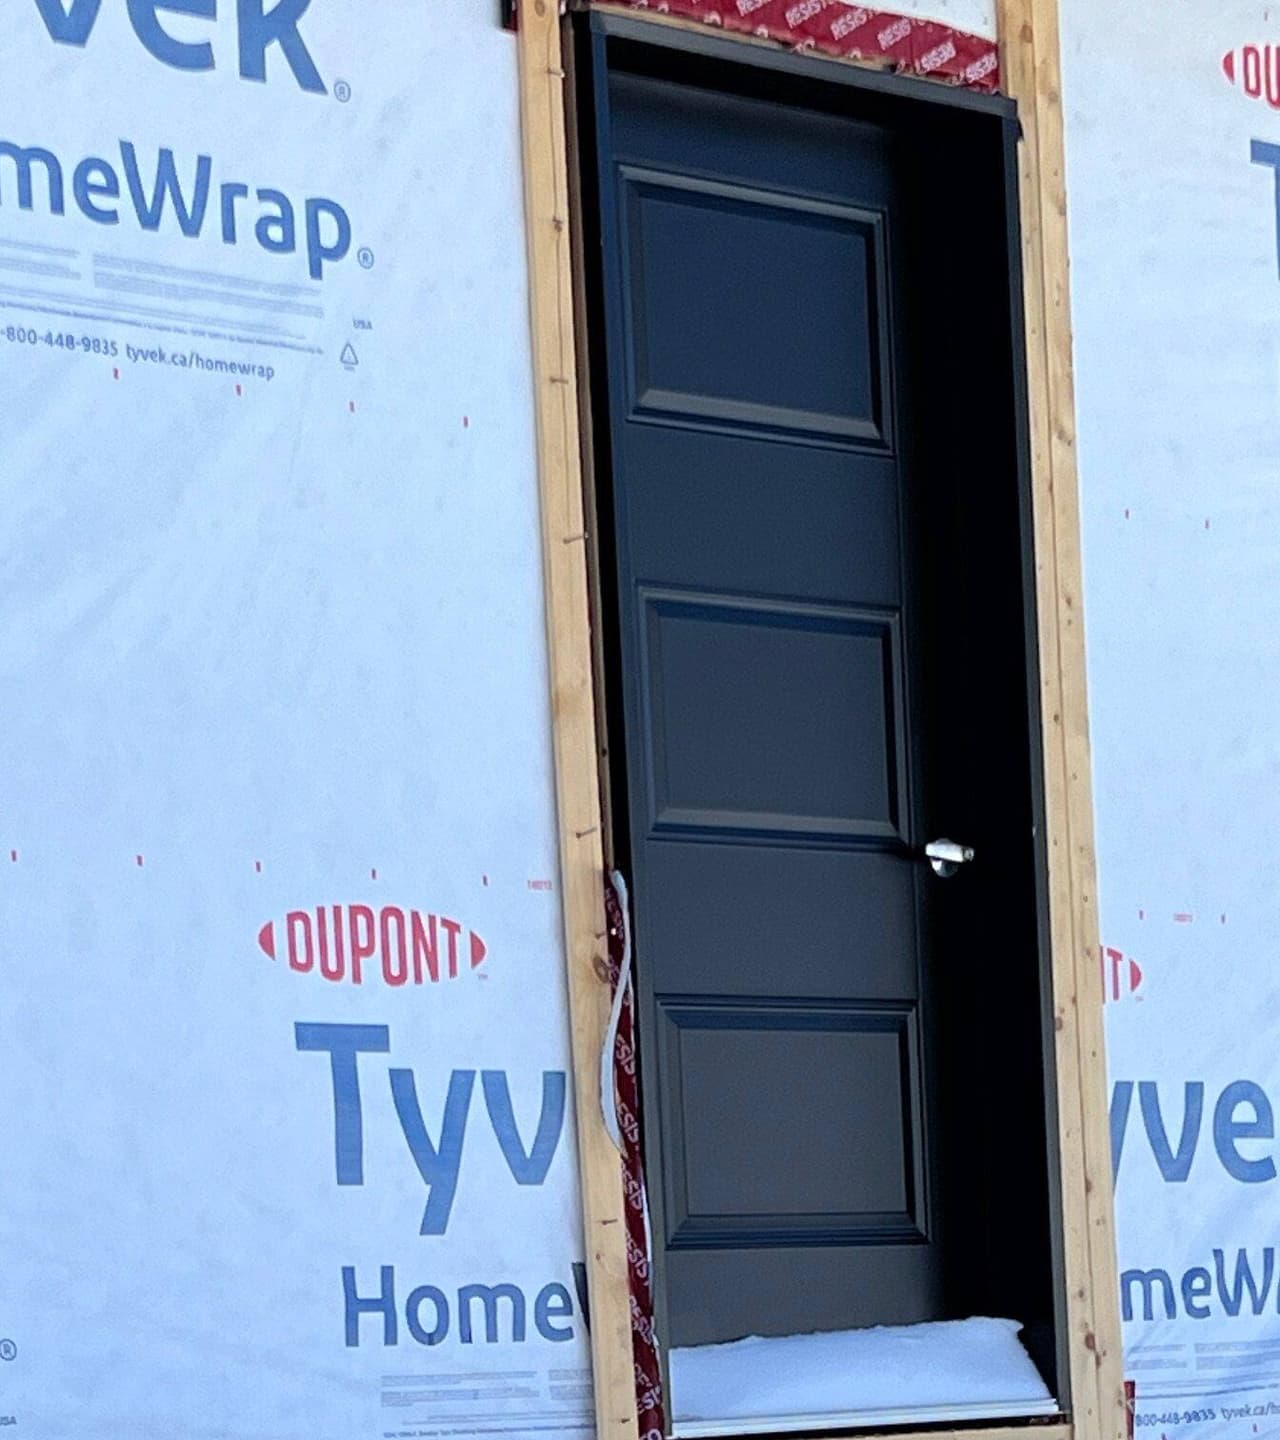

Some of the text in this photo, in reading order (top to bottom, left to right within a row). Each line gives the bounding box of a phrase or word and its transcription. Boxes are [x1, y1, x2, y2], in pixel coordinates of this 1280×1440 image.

[126, 343, 275, 381] tyvek.ca/homewrap
[286, 904, 461, 987] DUPONT
[294, 1022, 567, 1236] Tyv
[342, 1262, 592, 1348] Home
